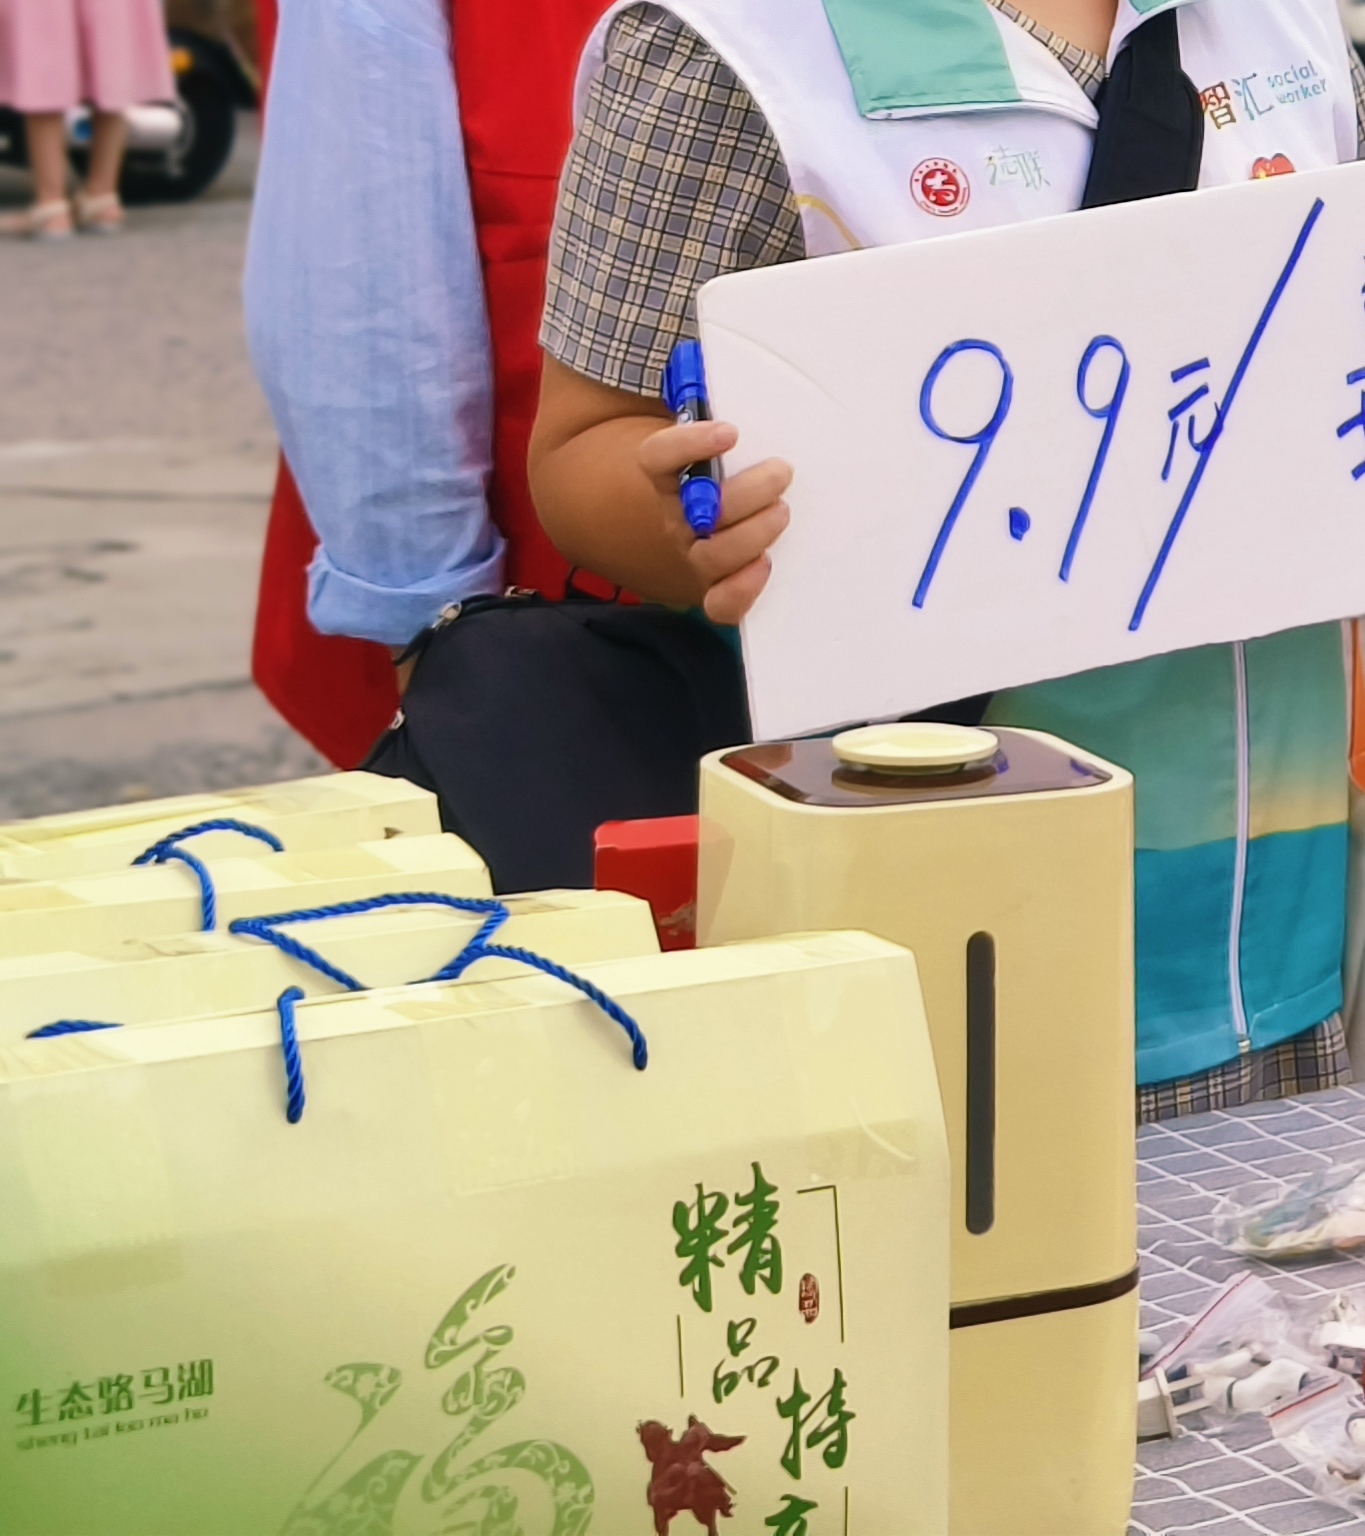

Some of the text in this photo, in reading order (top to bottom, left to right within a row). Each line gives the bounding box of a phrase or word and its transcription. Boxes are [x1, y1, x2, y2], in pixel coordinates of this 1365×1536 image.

[1267, 60, 1318, 88] social
[1277, 78, 1327, 105] worker
[1199, 72, 1274, 130] 智汇
[15, 1358, 215, 1429] 生态骆马湖
